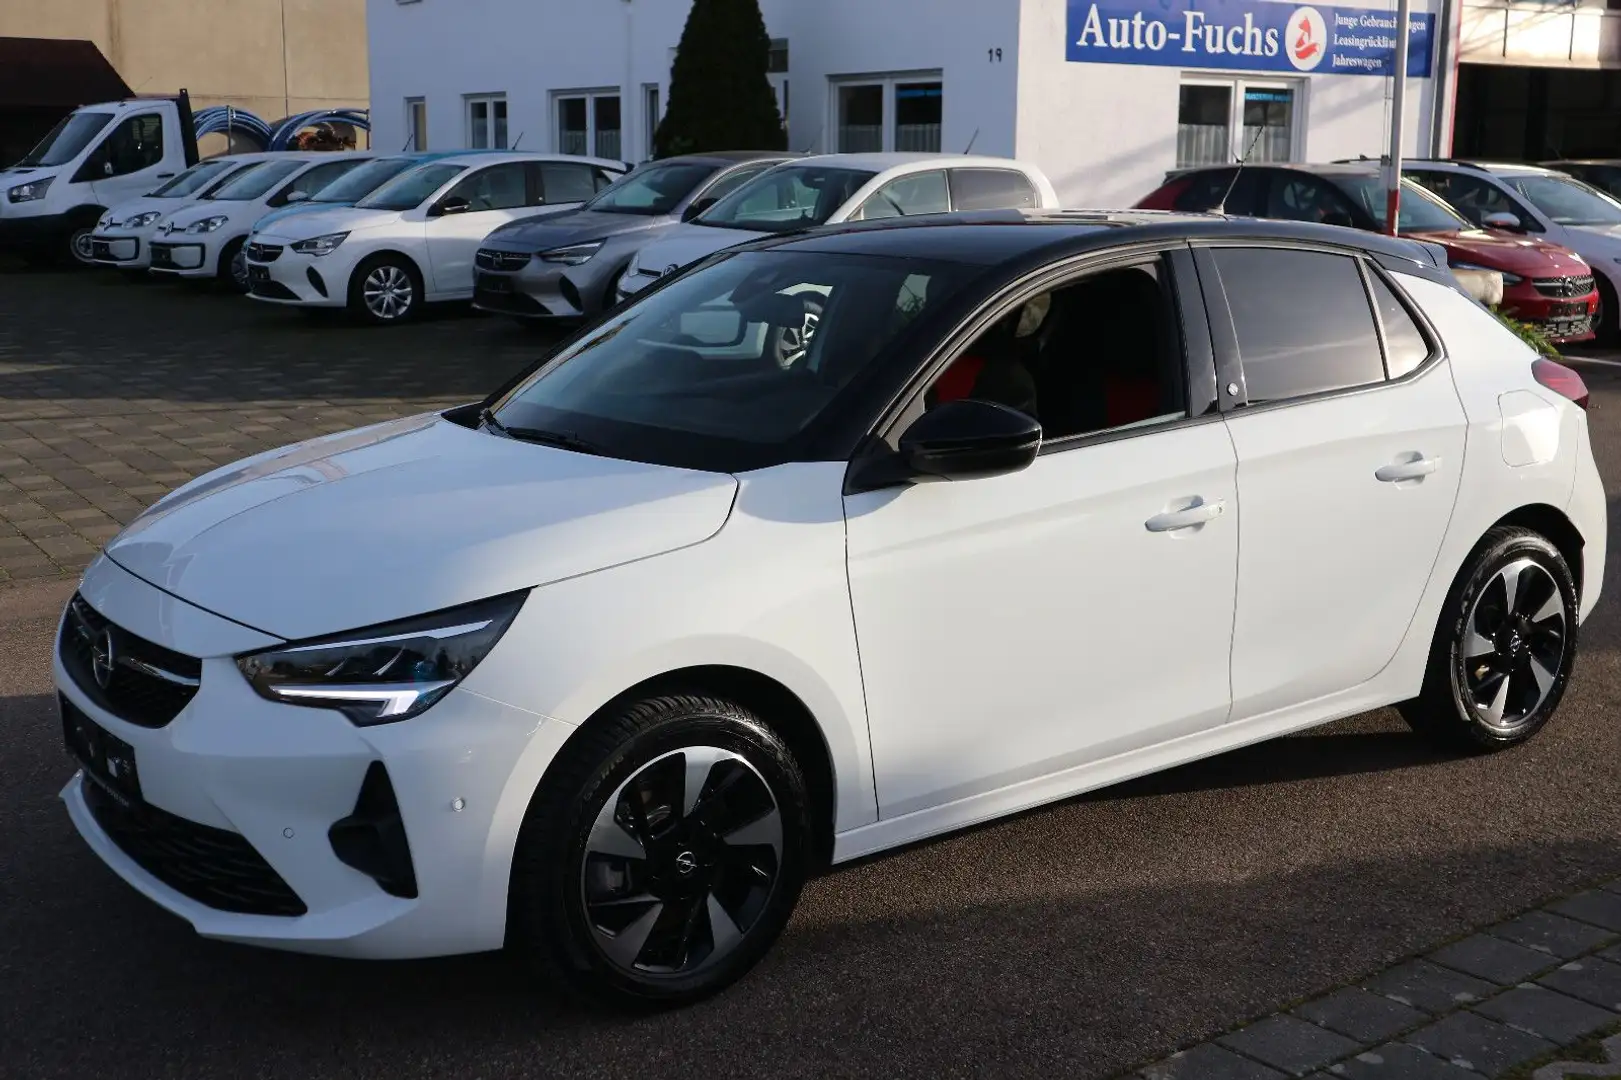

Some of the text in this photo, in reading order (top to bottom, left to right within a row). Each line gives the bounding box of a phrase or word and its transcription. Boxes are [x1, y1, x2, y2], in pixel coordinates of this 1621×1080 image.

[1335, 13, 1358, 29] Junge
[1077, 3, 1279, 56] Auto-Fuchs
[988, 48, 1003, 62] 19
[1332, 54, 1382, 70] Jahreswagen
